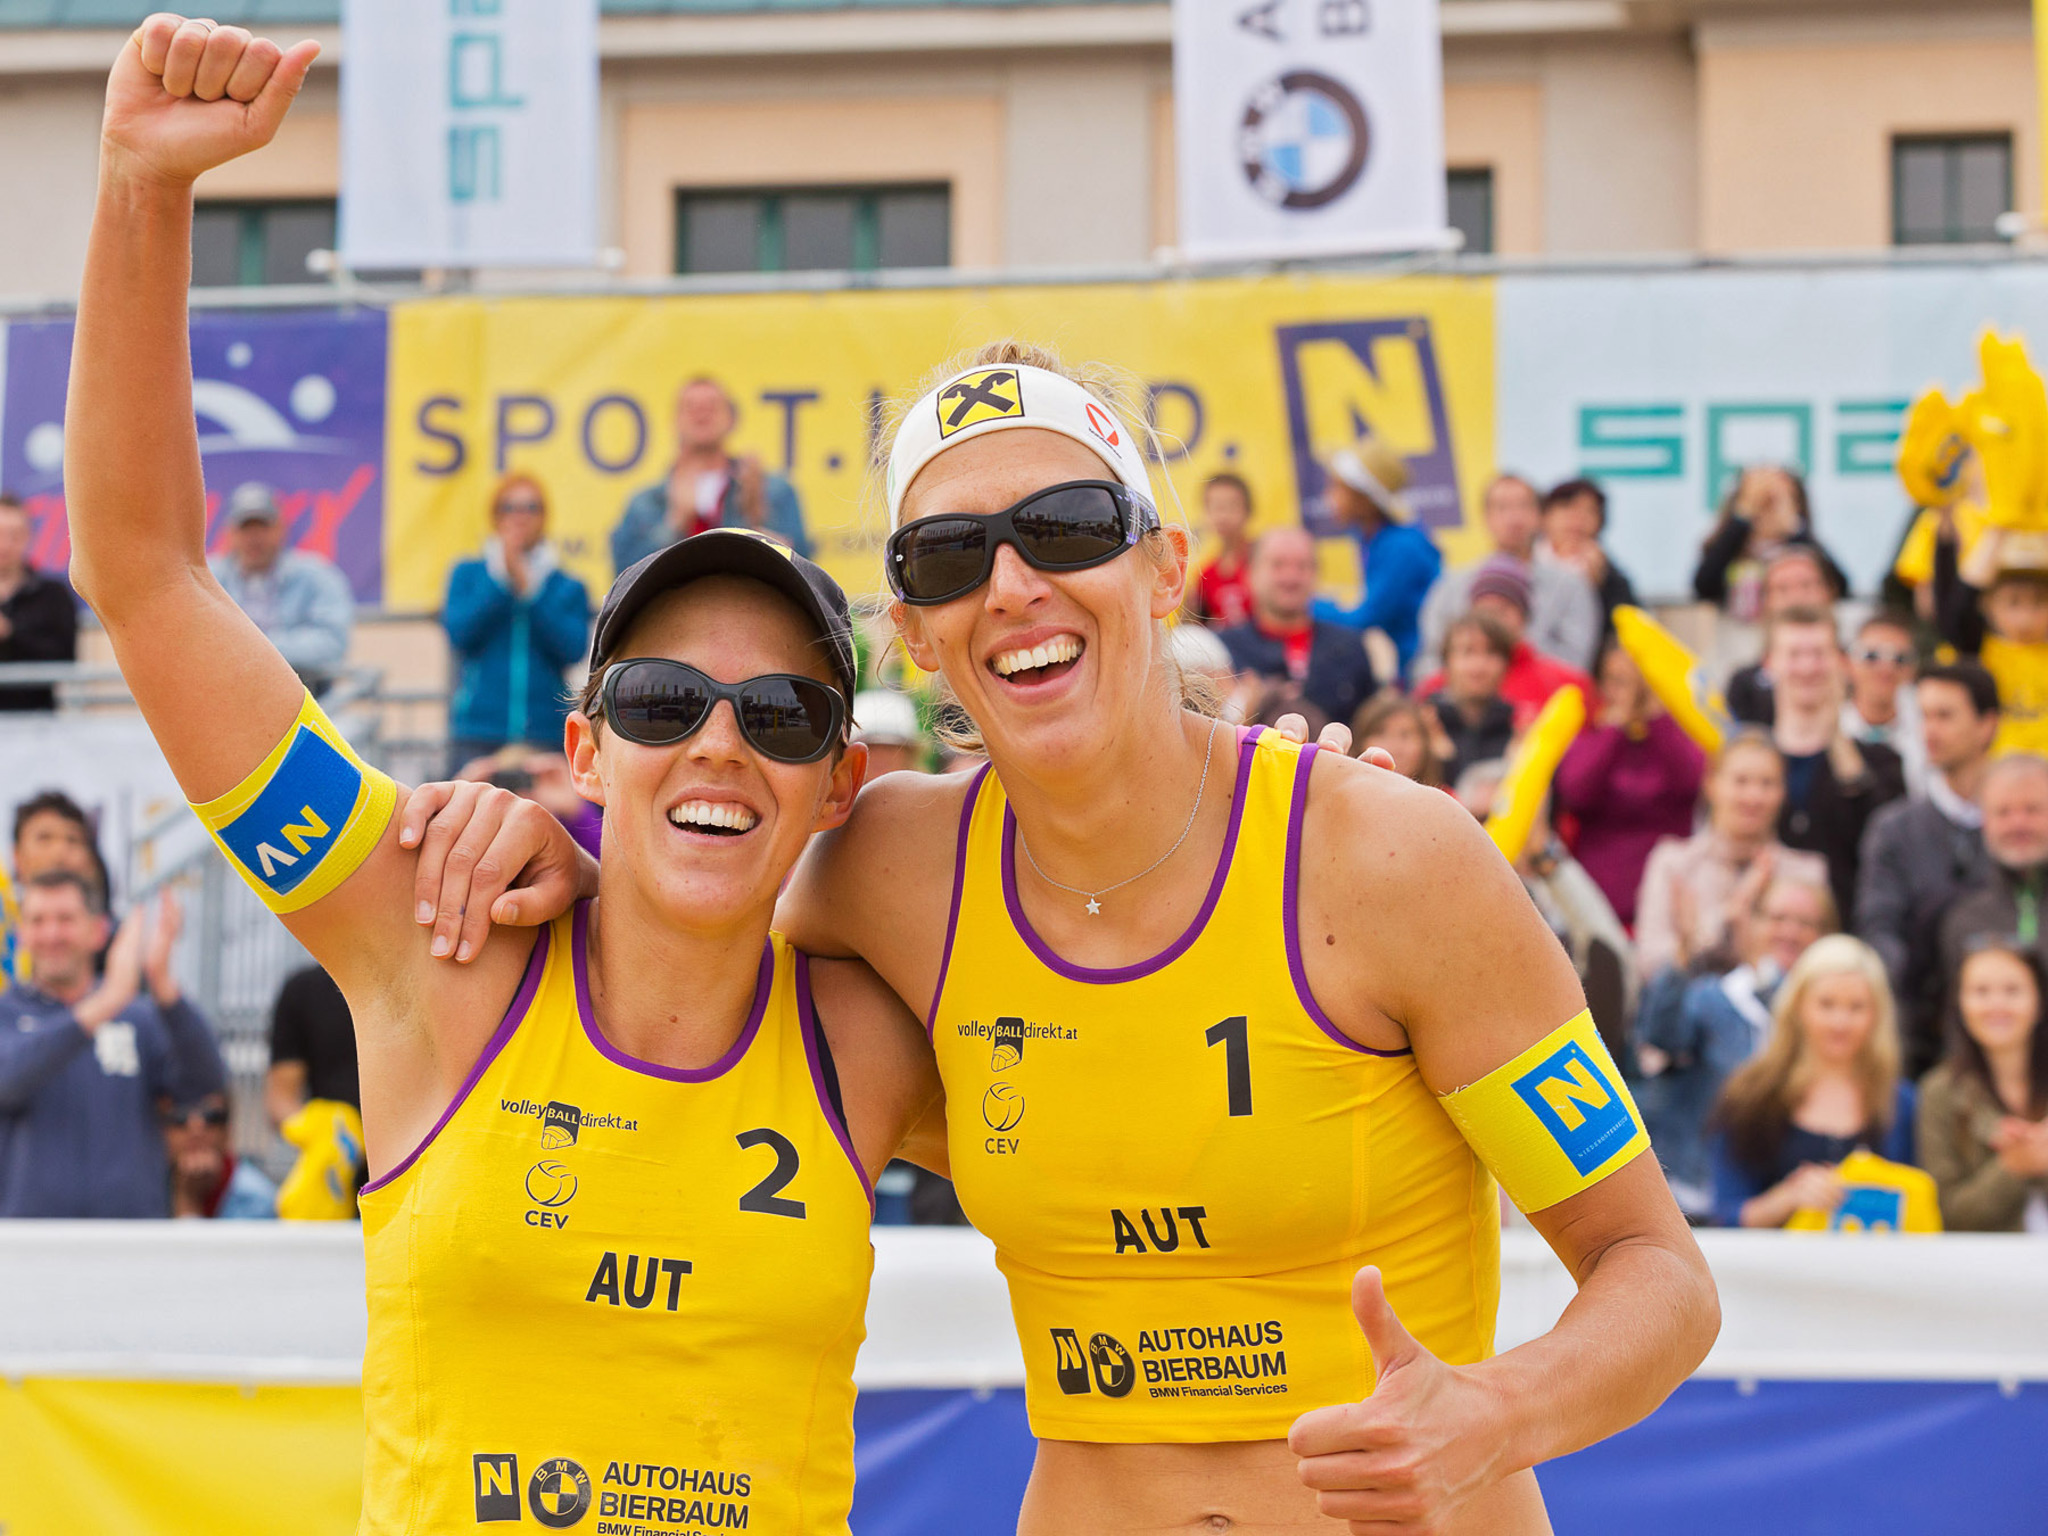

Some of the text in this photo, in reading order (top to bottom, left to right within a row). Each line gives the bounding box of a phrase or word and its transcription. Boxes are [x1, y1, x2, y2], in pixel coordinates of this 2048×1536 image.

[1205, 1015, 1253, 1117] 1
[985, 1138, 1020, 1154] CEV
[735, 1127, 807, 1220] 2
[524, 1210, 570, 1229] CEV
[1110, 1206, 1211, 1254] AUT
[585, 1251, 693, 1312] AUT
[1138, 1320, 1283, 1353] AUTOHAUS
[1142, 1351, 1287, 1383] BIERBAUM
[1149, 1383, 1288, 1398] BMW Financial Services
[602, 1461, 752, 1498] AUTOHAUS
[599, 1491, 749, 1529] BIERBAUM
[597, 1522, 632, 1535] BMW
